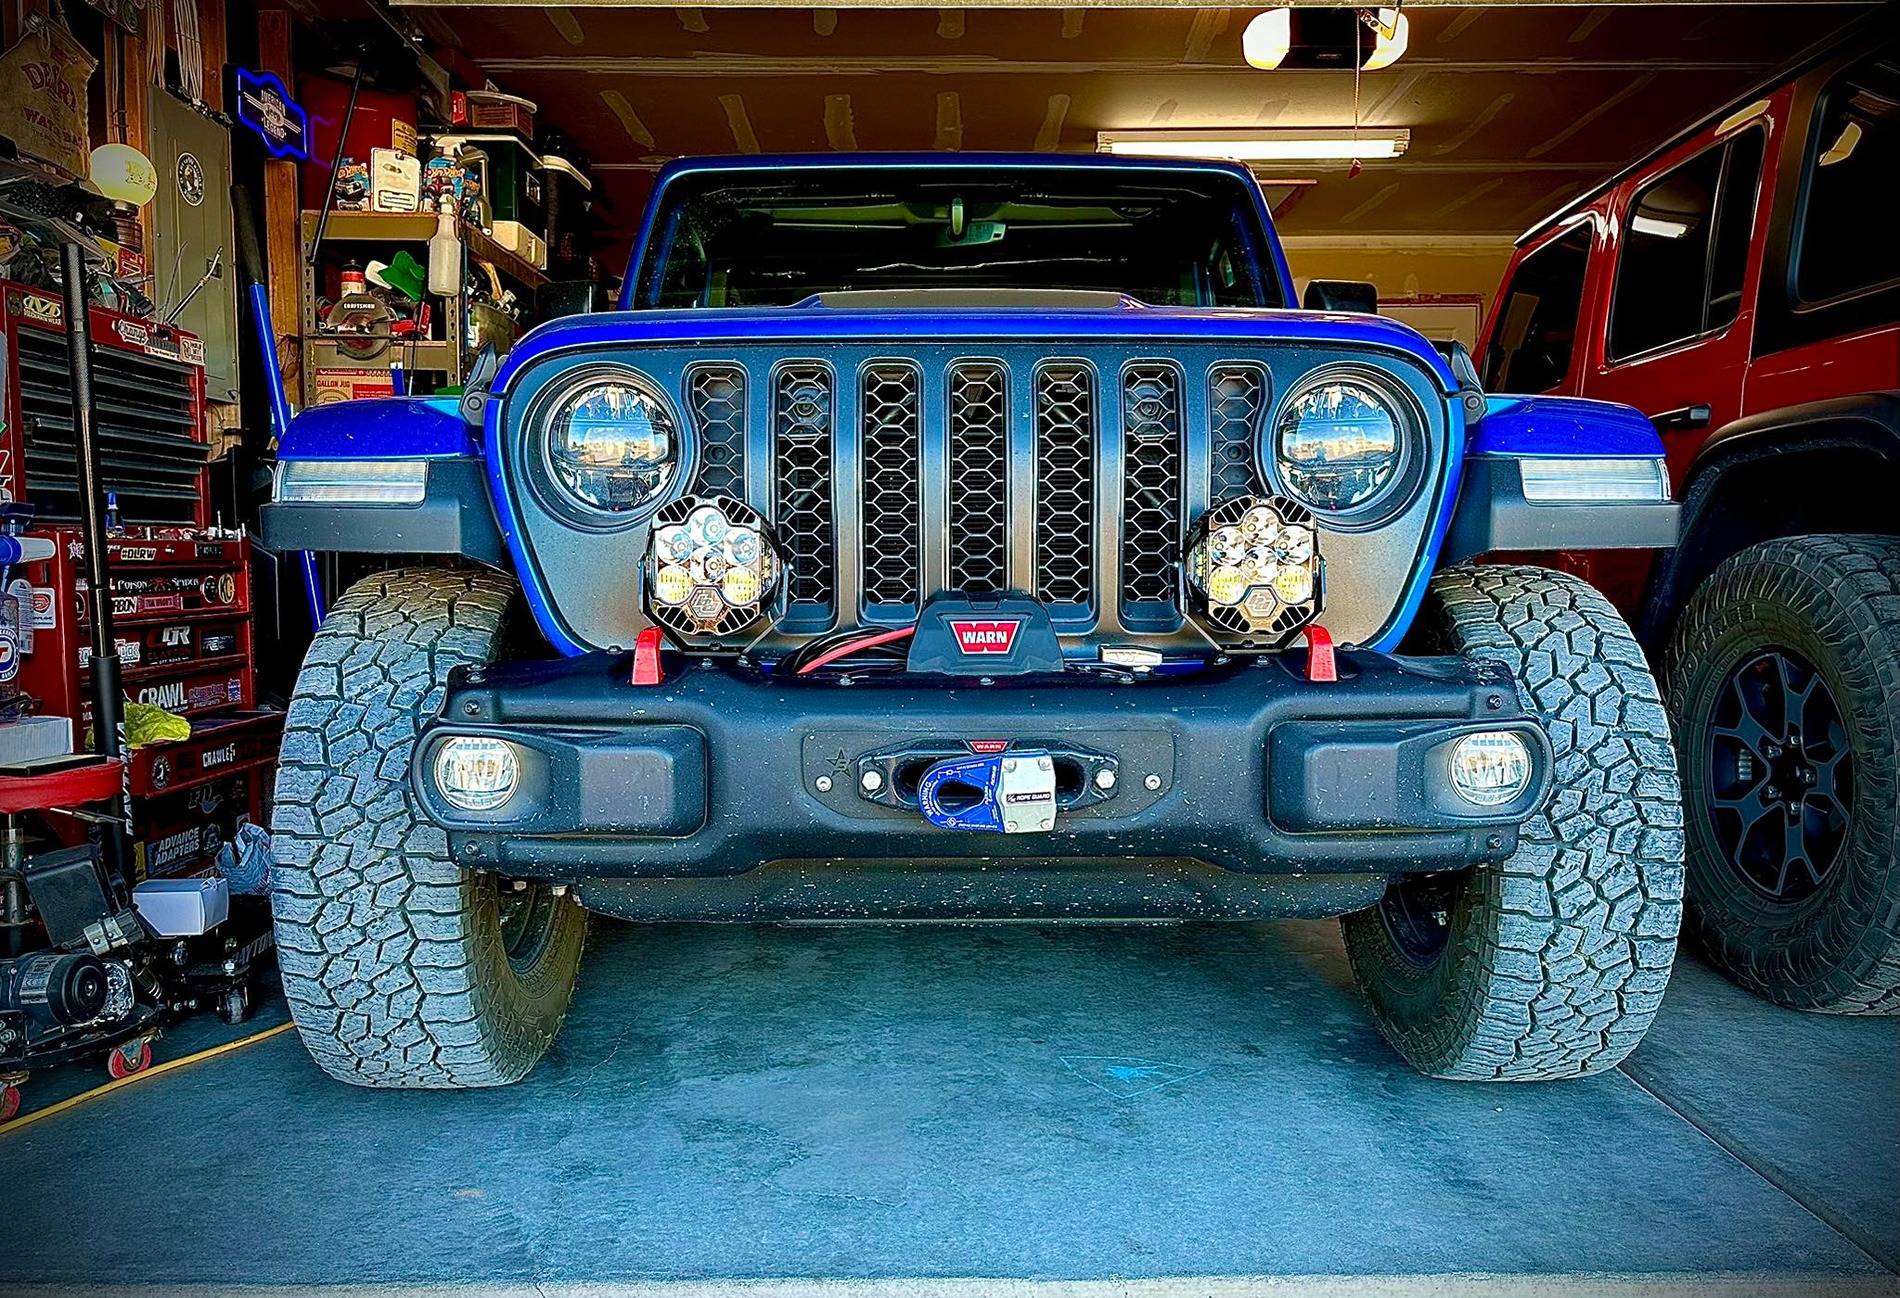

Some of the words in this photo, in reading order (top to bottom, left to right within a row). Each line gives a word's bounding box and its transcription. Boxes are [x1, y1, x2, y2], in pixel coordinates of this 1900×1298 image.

[316, 380, 338, 388] GALLON
[339, 380, 351, 388] JUG
[121, 547, 156, 560] #DLRW
[117, 579, 148, 591] POISON
[962, 631, 1008, 644] WARN
[139, 682, 188, 709] CRAWL
[158, 827, 200, 853] ADVANCE
[154, 839, 200, 866] ADAPTERS
